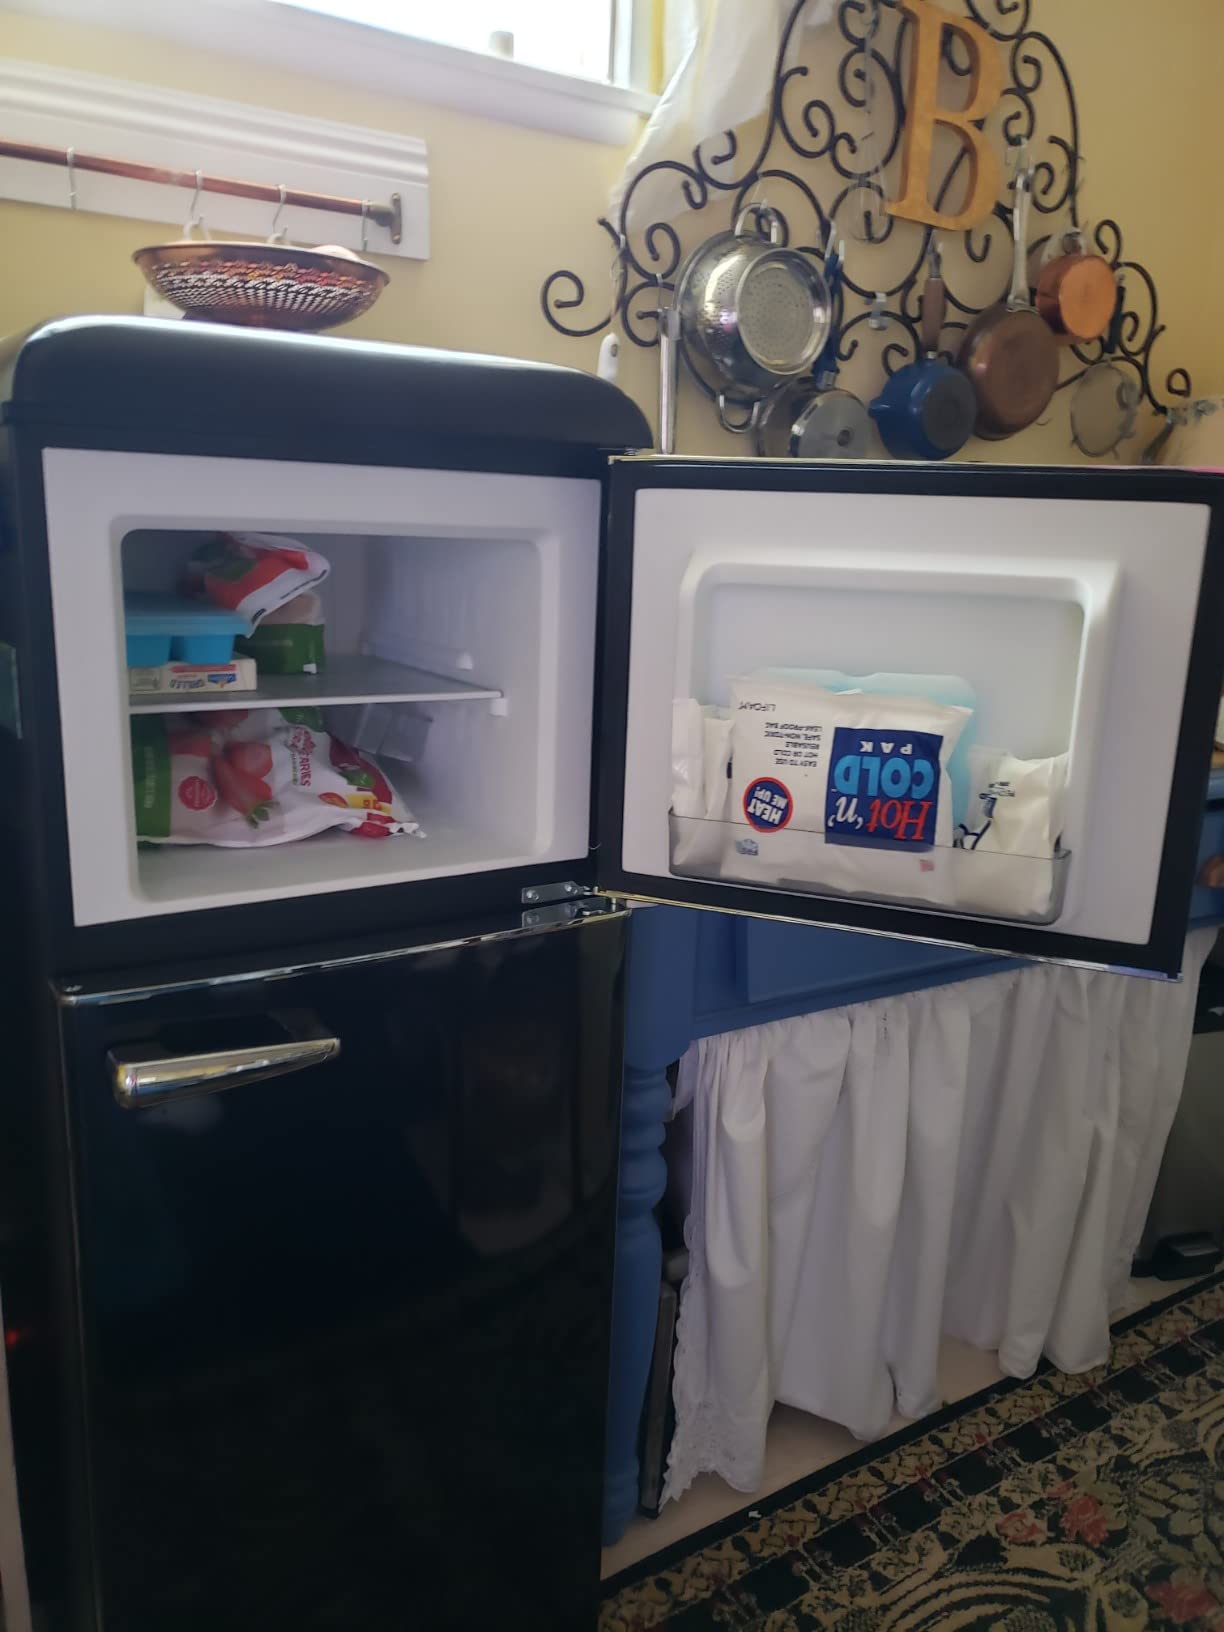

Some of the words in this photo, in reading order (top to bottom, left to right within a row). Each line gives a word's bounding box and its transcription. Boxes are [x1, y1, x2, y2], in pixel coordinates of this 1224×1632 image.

[885, 0, 1005, 231] B
[773, 749, 792, 757] COLD
[785, 741, 820, 750] REUSABLE
[833, 754, 935, 800] COLD
[753, 786, 772, 800] UP!
[770, 794, 788, 809] ME
[746, 798, 783, 826] HEAT
[865, 798, 933, 840] Hot
